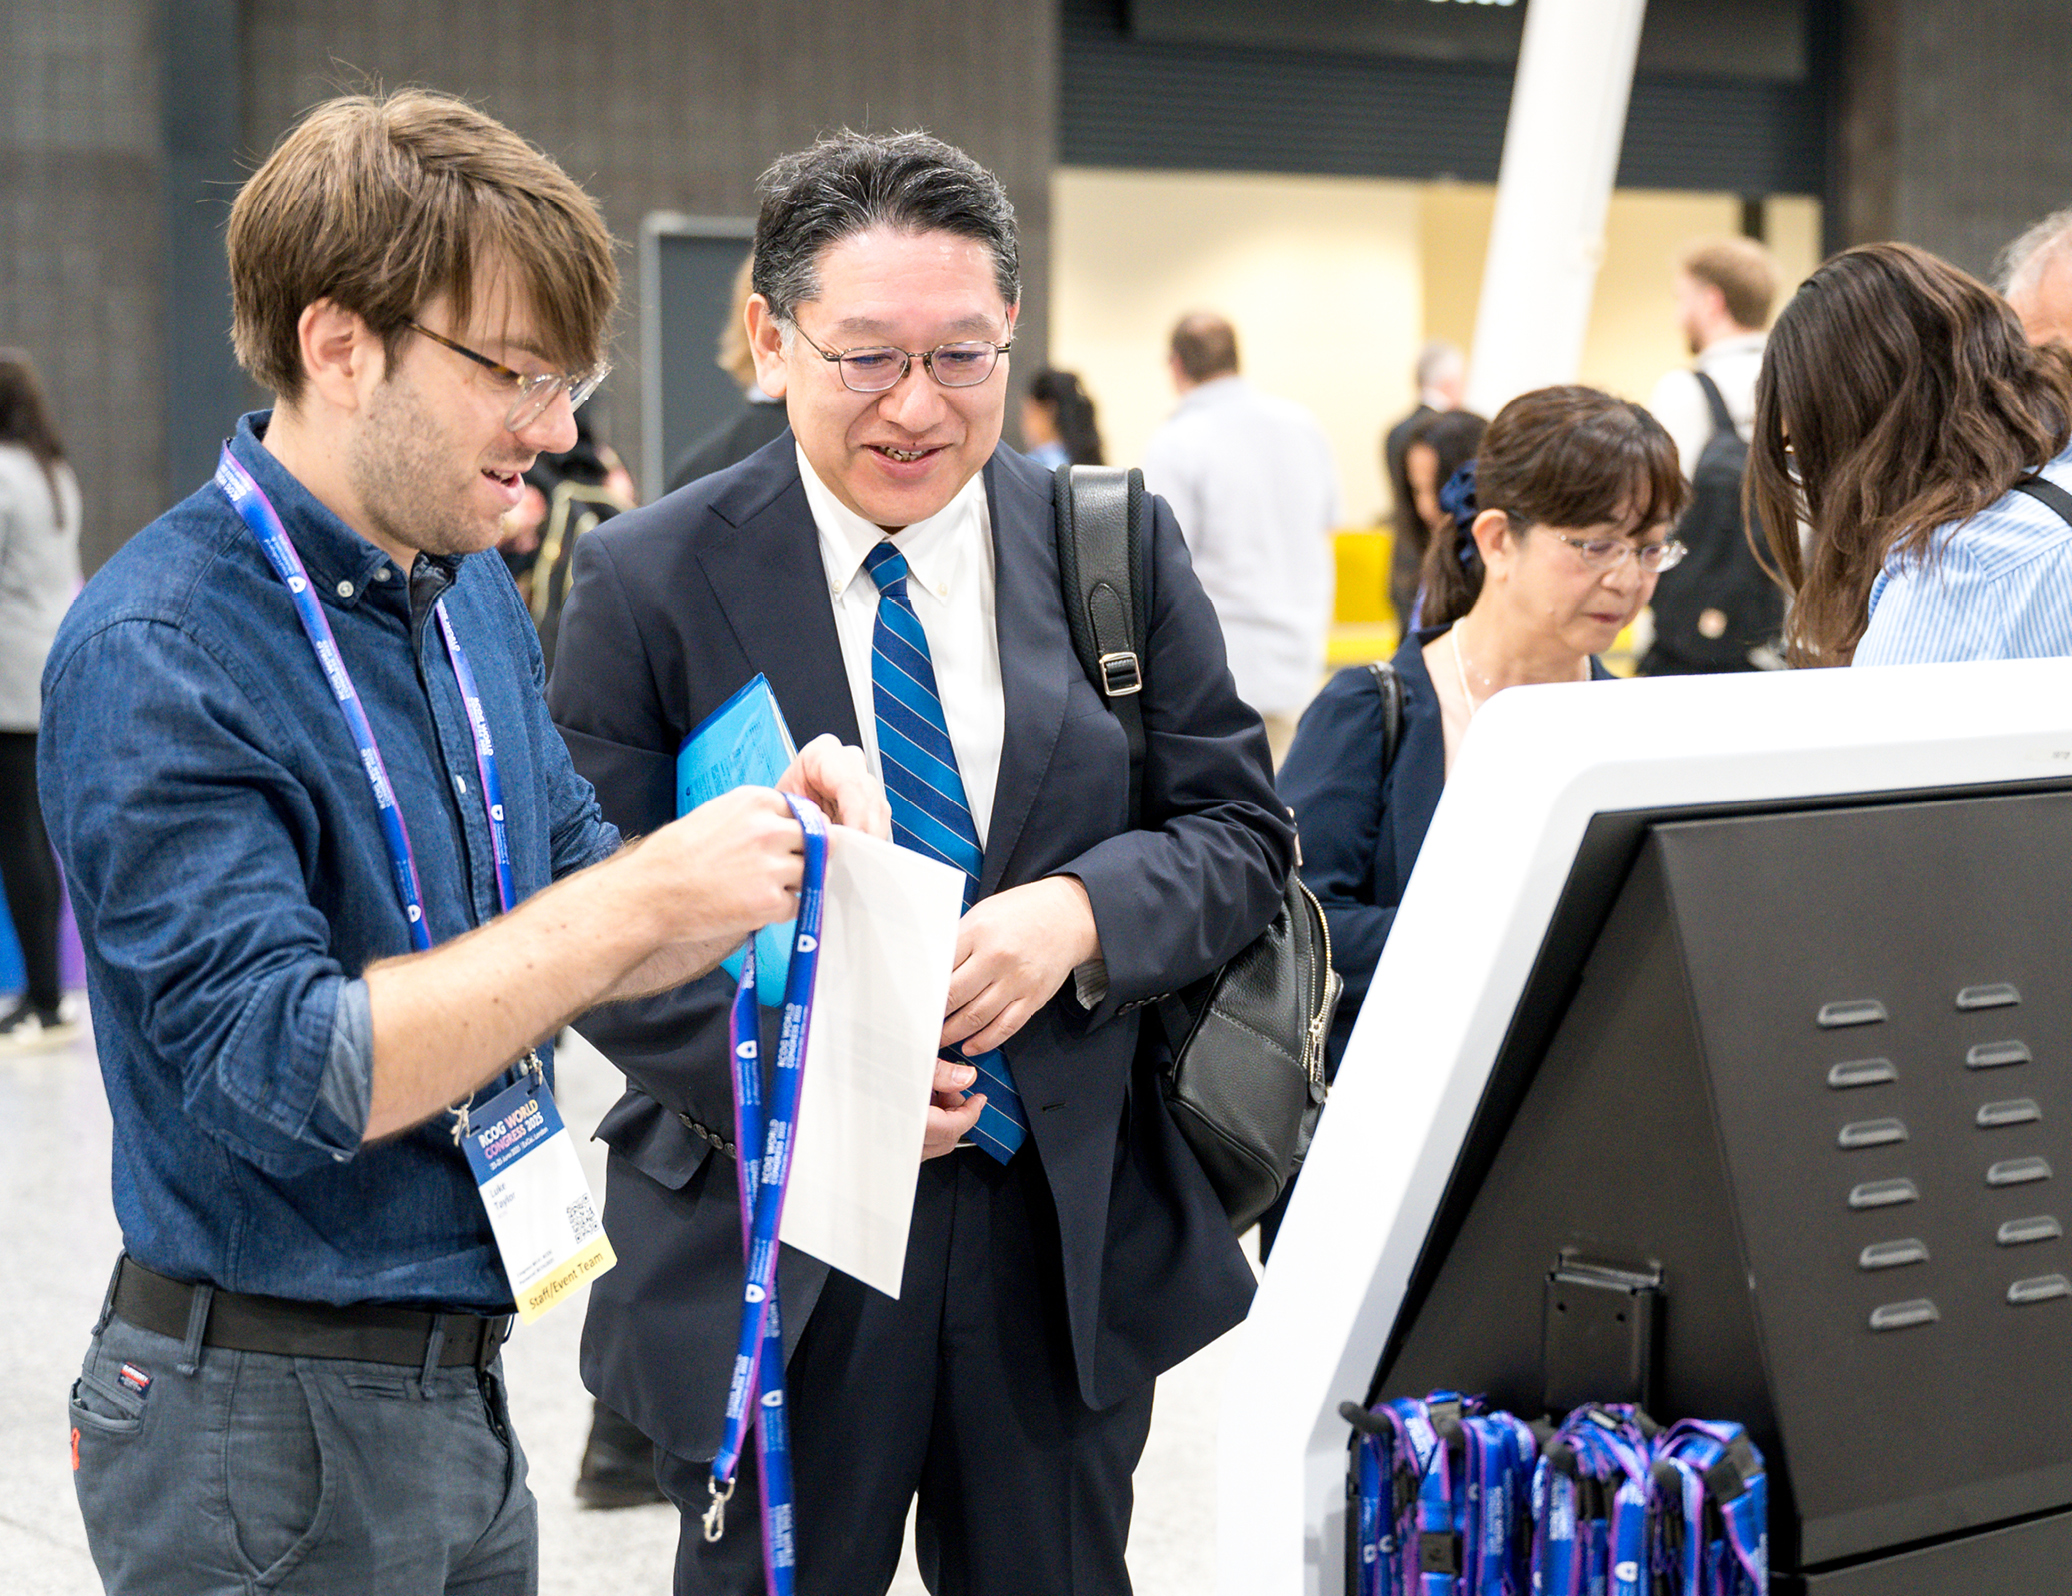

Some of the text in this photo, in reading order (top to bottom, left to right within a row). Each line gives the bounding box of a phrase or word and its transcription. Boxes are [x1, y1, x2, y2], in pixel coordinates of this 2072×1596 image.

[478, 1099, 538, 1148] RCOG WORLD
[485, 1111, 544, 1159] CONGRESS 2025
[488, 1182, 506, 1198] Luke
[493, 1192, 516, 1211] Taylor
[528, 1269, 579, 1310] Staff/Event
[577, 1252, 604, 1274] Team
